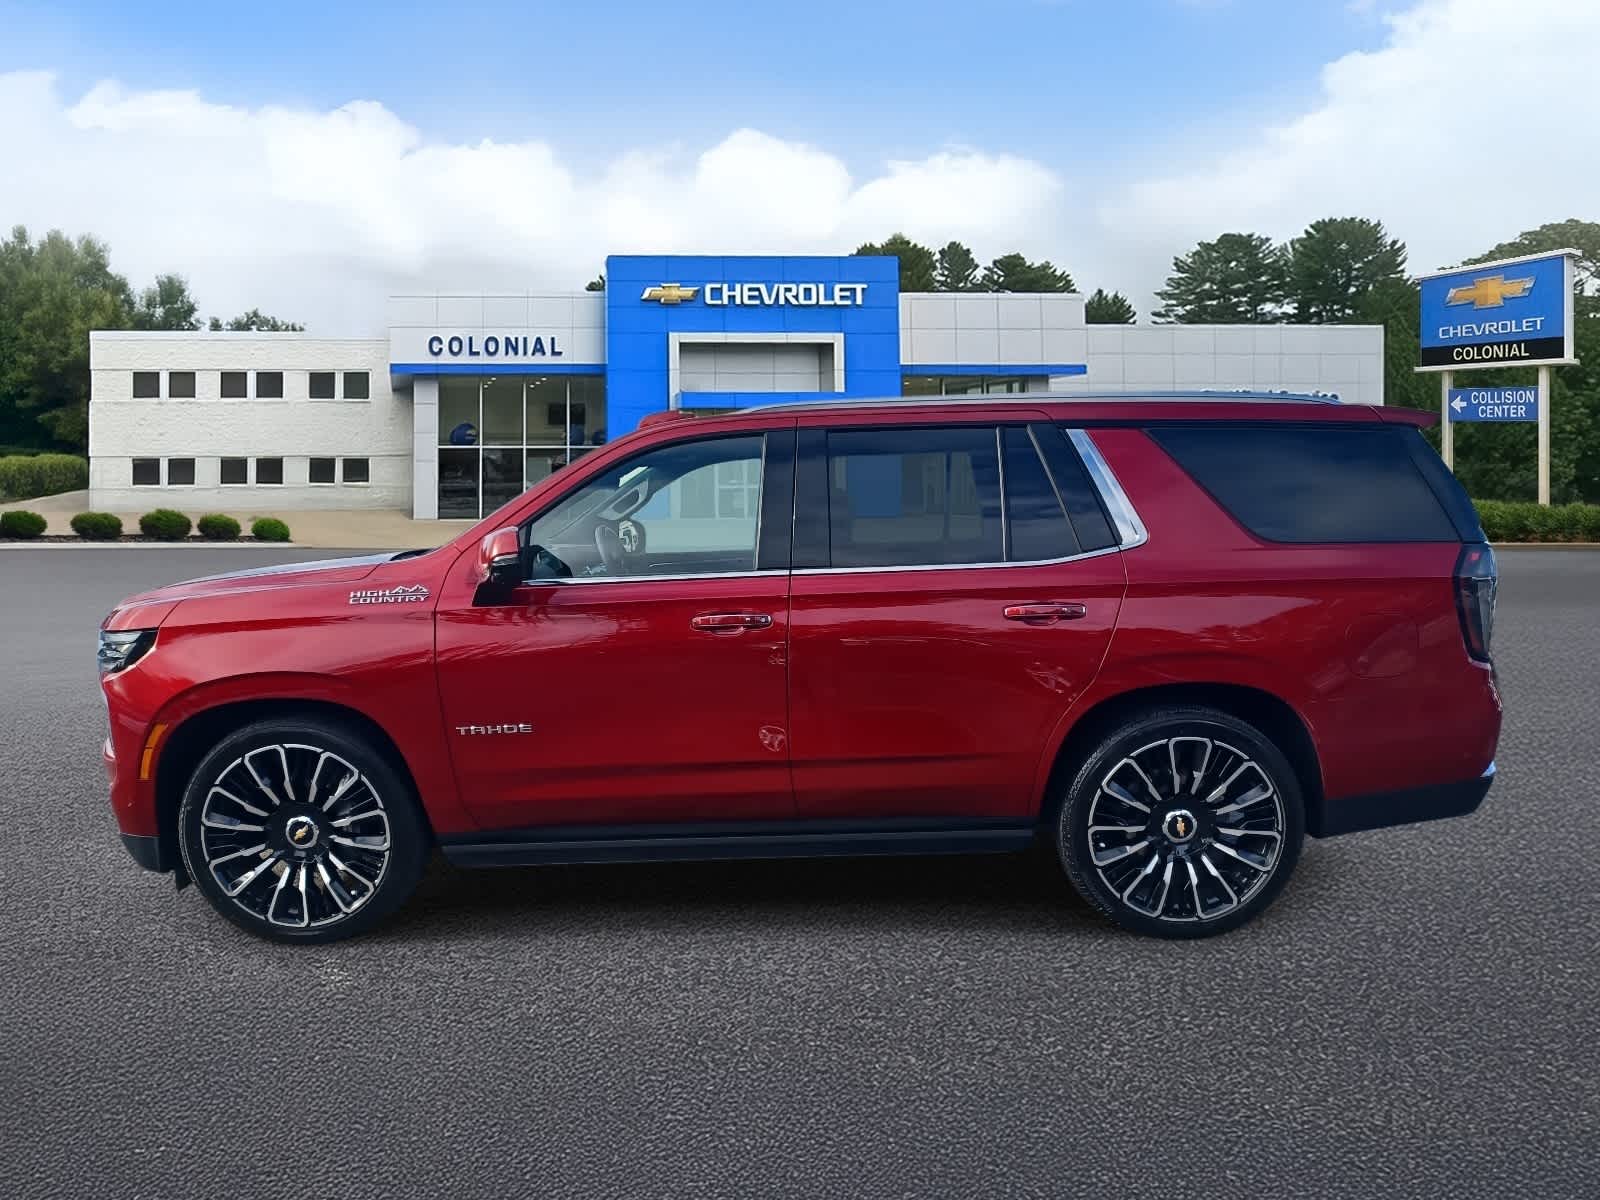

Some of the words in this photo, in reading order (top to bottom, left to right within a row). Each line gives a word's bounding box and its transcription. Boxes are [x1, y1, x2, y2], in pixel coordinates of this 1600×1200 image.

[703, 282, 869, 306] CHEVROLET
[1438, 316, 1545, 339] CHEVROLET
[427, 335, 564, 357] COLONIAL
[1452, 342, 1530, 361] COLONIAL
[1470, 390, 1535, 404] COLLISION
[1478, 405, 1526, 418] CENTER
[348, 595, 430, 605] COUNTRY
[349, 589, 391, 598] HIGH
[455, 723, 534, 736] TAHOE
